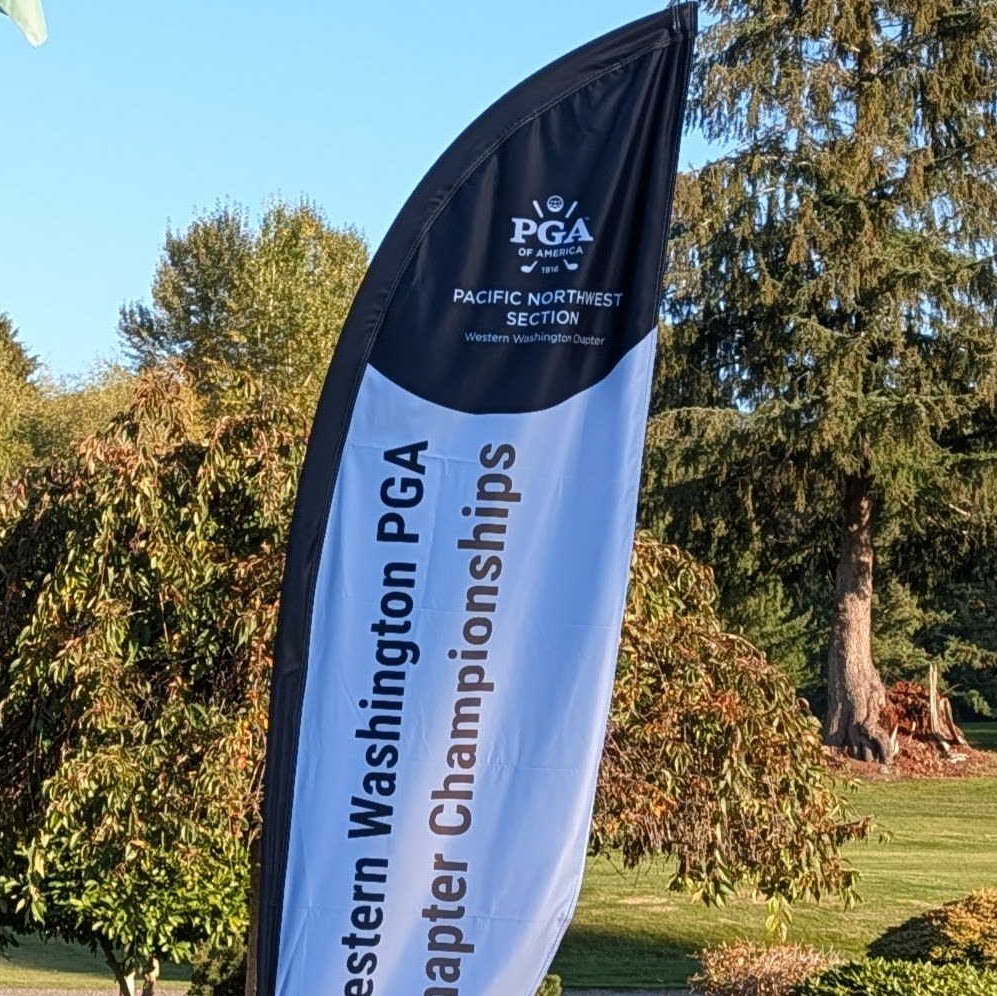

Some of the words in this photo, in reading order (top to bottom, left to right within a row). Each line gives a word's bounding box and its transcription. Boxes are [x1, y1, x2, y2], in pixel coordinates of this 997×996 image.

[509, 217, 594, 246] PGA
[518, 247, 534, 257] OF
[536, 245, 584, 259] AMERICA
[541, 265, 560, 274] 1916
[453, 288, 522, 306] PACIFIC
[527, 289, 623, 307] NORTHWEST
[506, 310, 580, 327] SECTION
[464, 332, 510, 343] Western
[513, 332, 572, 344] Washington
[573, 333, 606, 346] Chapter
[376, 440, 429, 544] PGA
[428, 443, 522, 836] Championships
[347, 561, 421, 839] Washington
